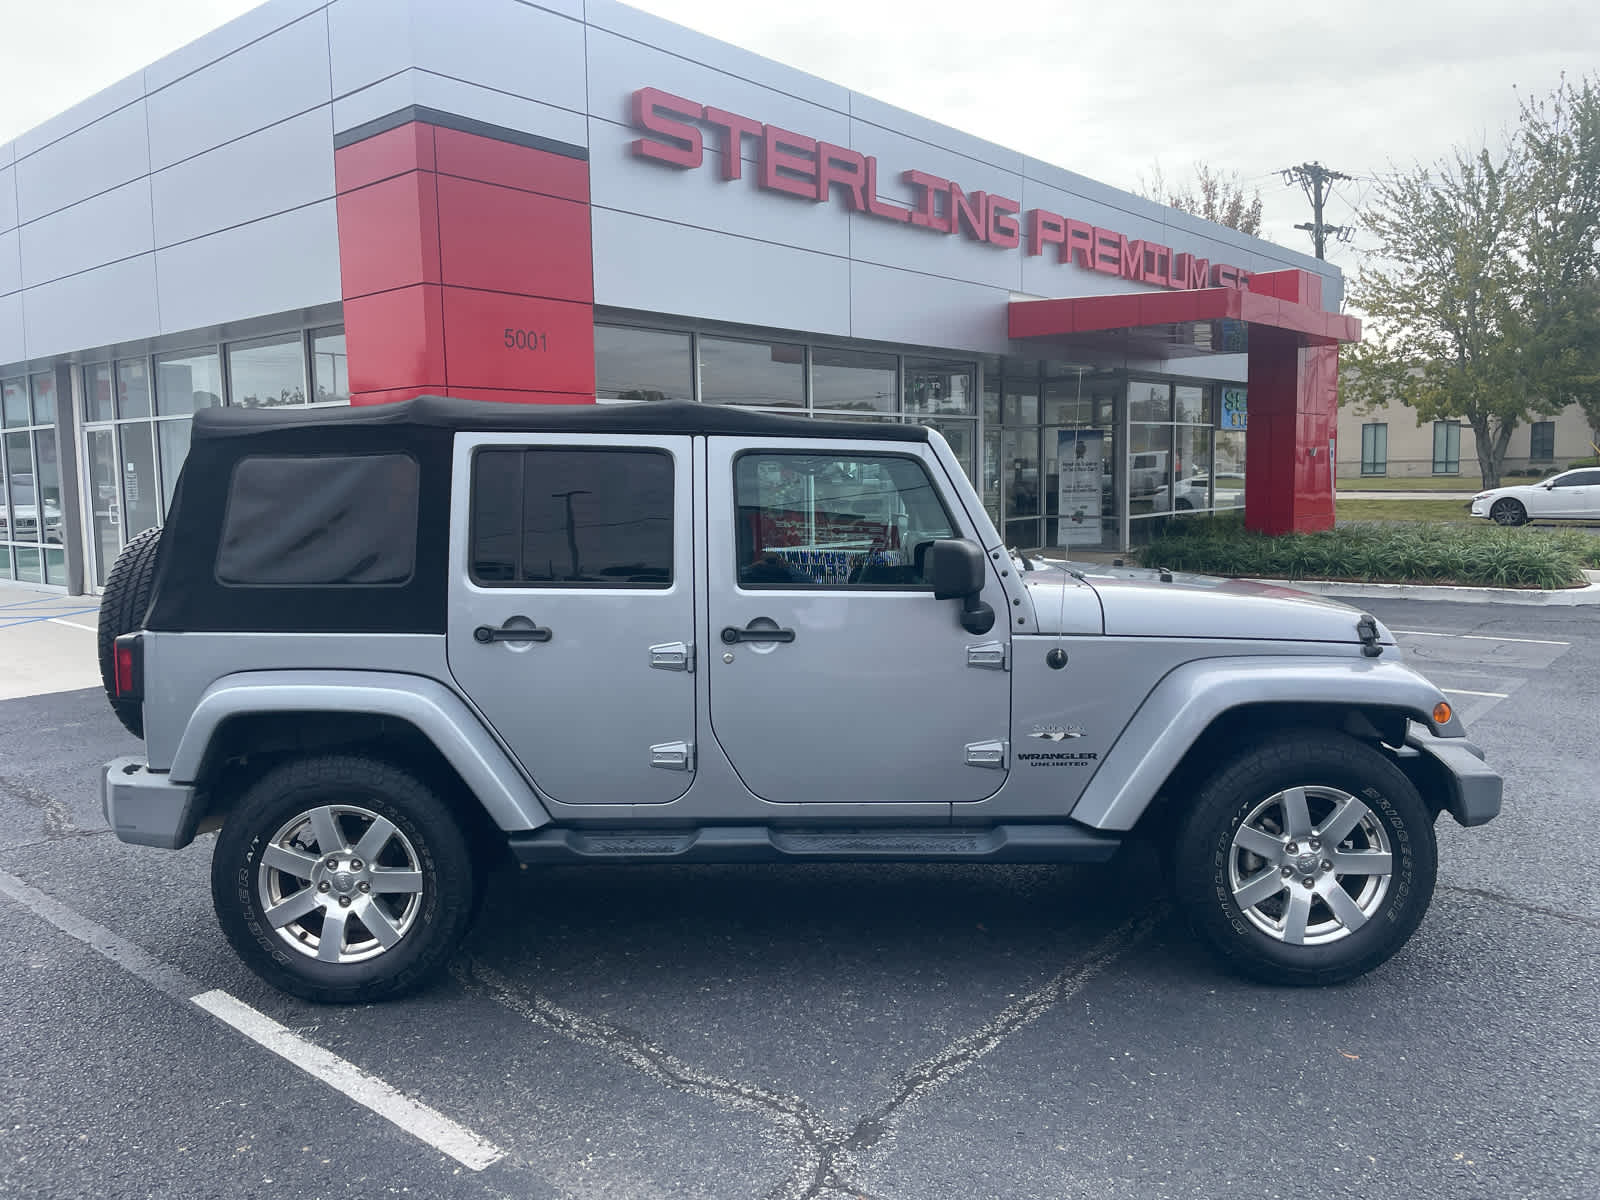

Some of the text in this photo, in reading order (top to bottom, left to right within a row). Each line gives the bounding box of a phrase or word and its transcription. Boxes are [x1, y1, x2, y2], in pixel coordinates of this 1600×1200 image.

[631, 86, 1210, 290] STERLING PREMIUM
[503, 327, 547, 353] 5001
[1017, 752, 1098, 760] WRANGLER
[1362, 787, 1412, 923] BRIDGESTONE
[238, 868, 295, 965] DUELER
